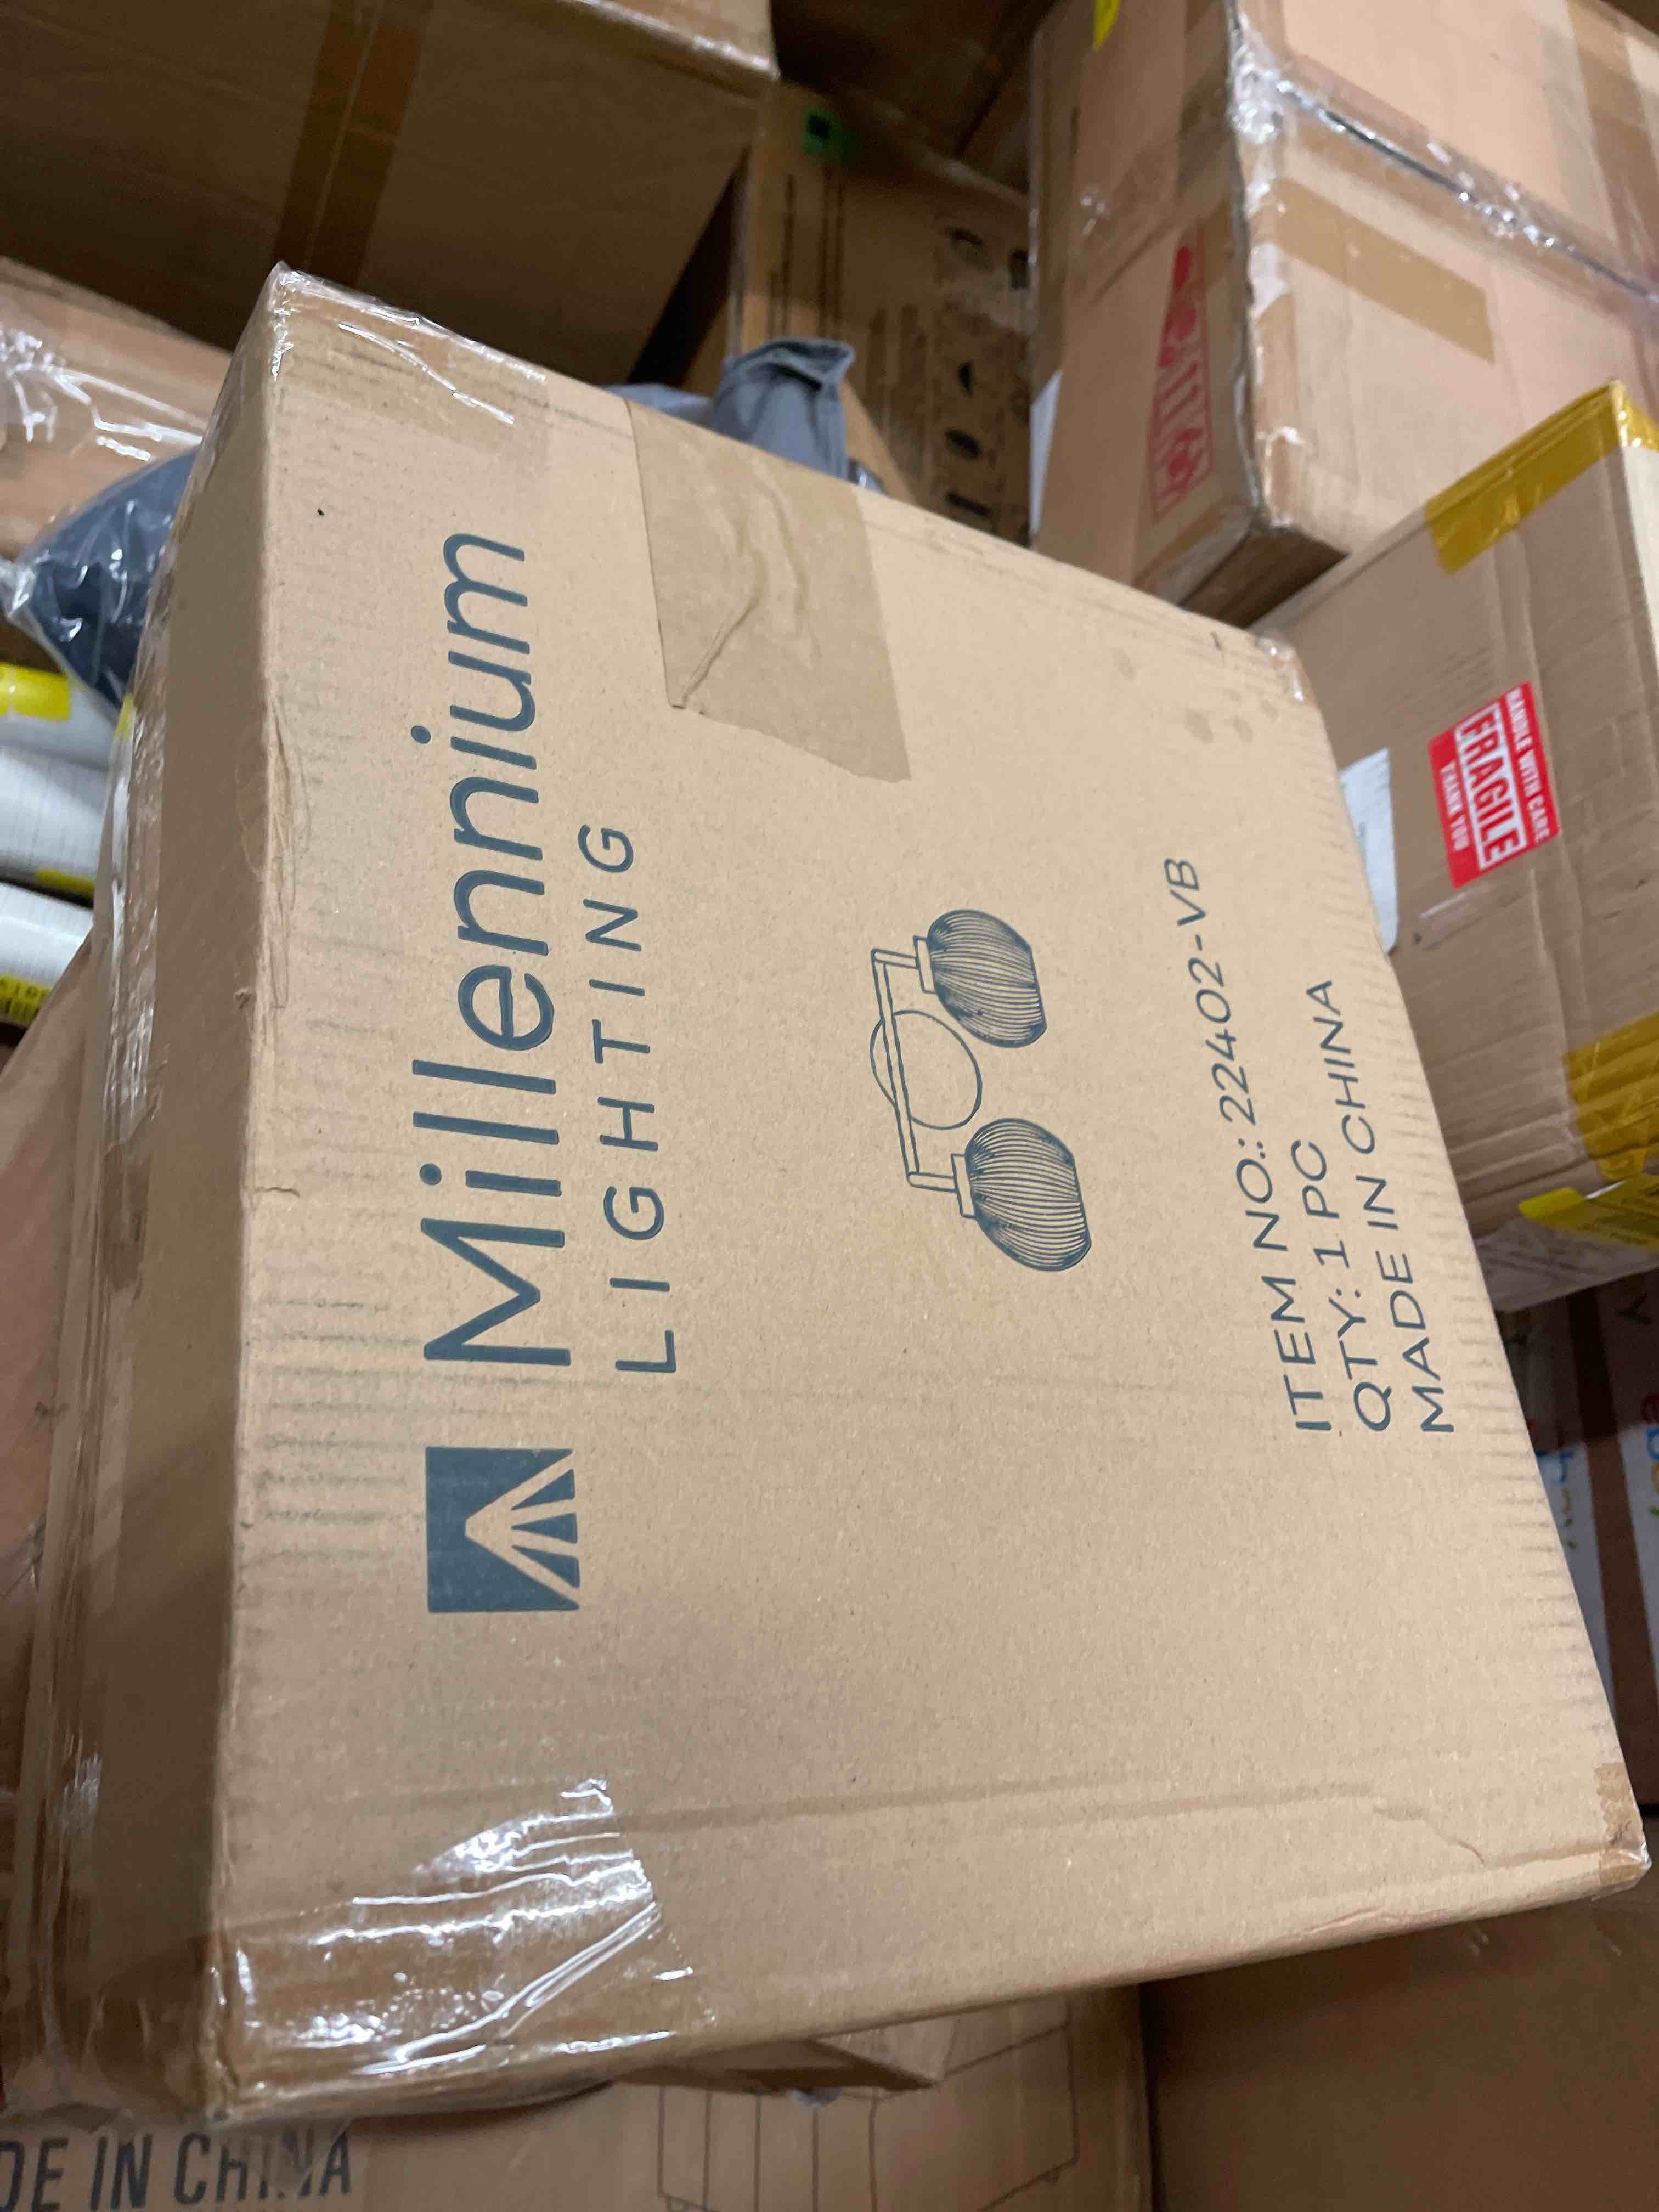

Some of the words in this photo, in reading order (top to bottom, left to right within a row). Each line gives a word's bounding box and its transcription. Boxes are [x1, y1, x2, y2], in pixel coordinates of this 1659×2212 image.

[1450, 815, 1470, 852] YOU
[1460, 712, 1520, 863] FRAGILE
[1519, 750, 1542, 799] WITH
[1527, 795, 1550, 843] CARE
[410, 533, 571, 1367] Millennium
[1164, 858, 1256, 1126] 22402-VB
[578, 824, 677, 1373] LIGHTING
[1306, 980, 1376, 1155] CHINA
[1235, 1137, 1288, 1251] NO.:
[1291, 1139, 1339, 1219] PC
[1355, 1175, 1399, 1230] IN
[1313, 1240, 1350, 1268] 1
[1261, 1275, 1332, 1431] ITEM
[1328, 1288, 1392, 1431] QTY:
[1372, 1250, 1455, 1432] MADE
[90, 2134, 153, 2211] IN
